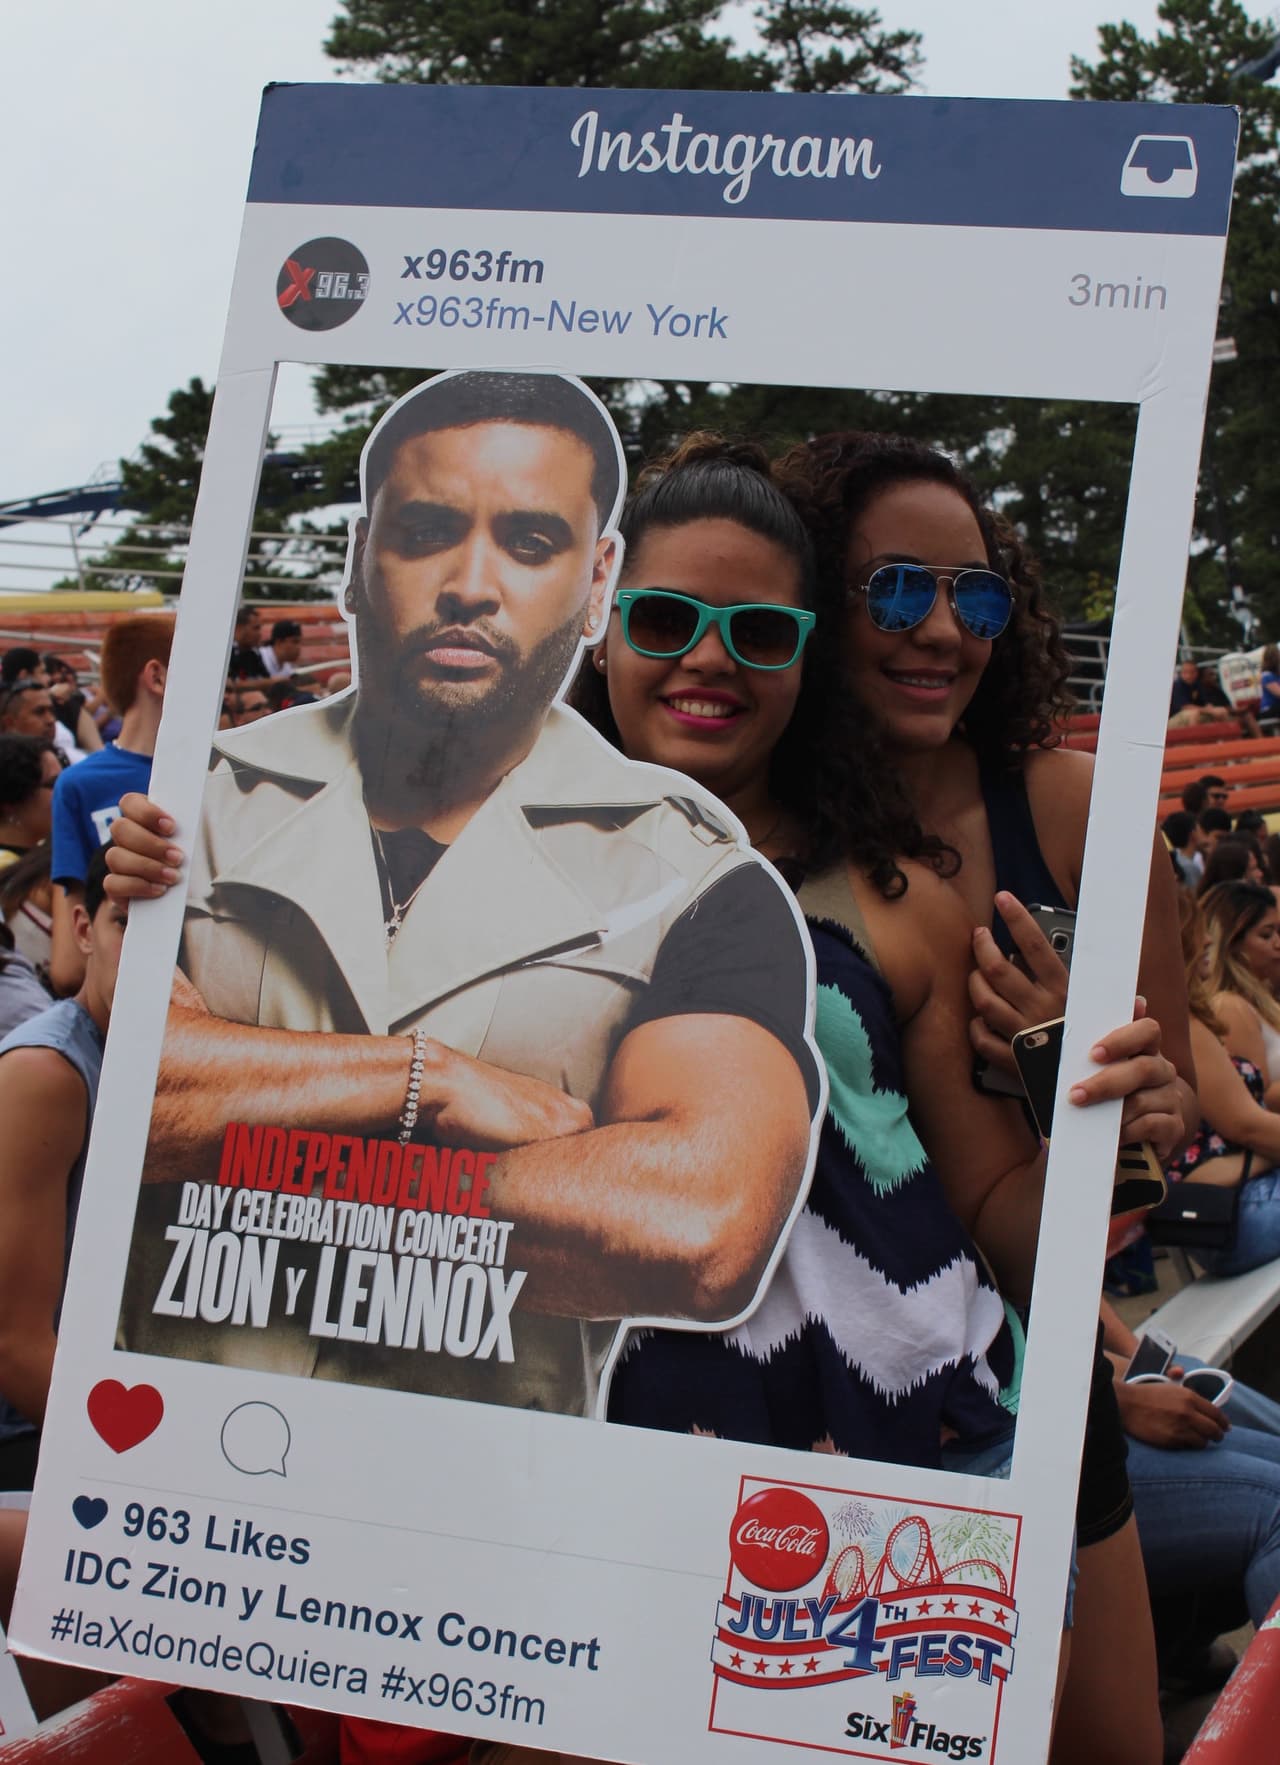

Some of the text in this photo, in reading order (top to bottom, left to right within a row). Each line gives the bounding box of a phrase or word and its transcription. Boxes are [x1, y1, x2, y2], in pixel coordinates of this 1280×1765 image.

[571, 111, 881, 204] Instagram
[400, 248, 545, 284] x963fm
[1068, 273, 1167, 311] 3min
[393, 295, 729, 339] x963fm-New York
[218, 1121, 498, 1218] INDEPENDENCE
[178, 1181, 514, 1266] DAY CELEBRATION CONCERT
[152, 1225, 528, 1363] ZION Y LENNOX
[123, 1502, 312, 1565] 963 Likes
[64, 1550, 602, 1671] IDC Zion y Lennox Concert
[727, 1592, 841, 1640] JULY
[50, 1608, 546, 1725] #laXdondeQuiera #x963fm
[886, 1634, 1003, 1685] FEST
[844, 1712, 985, 1760] Six Flags
